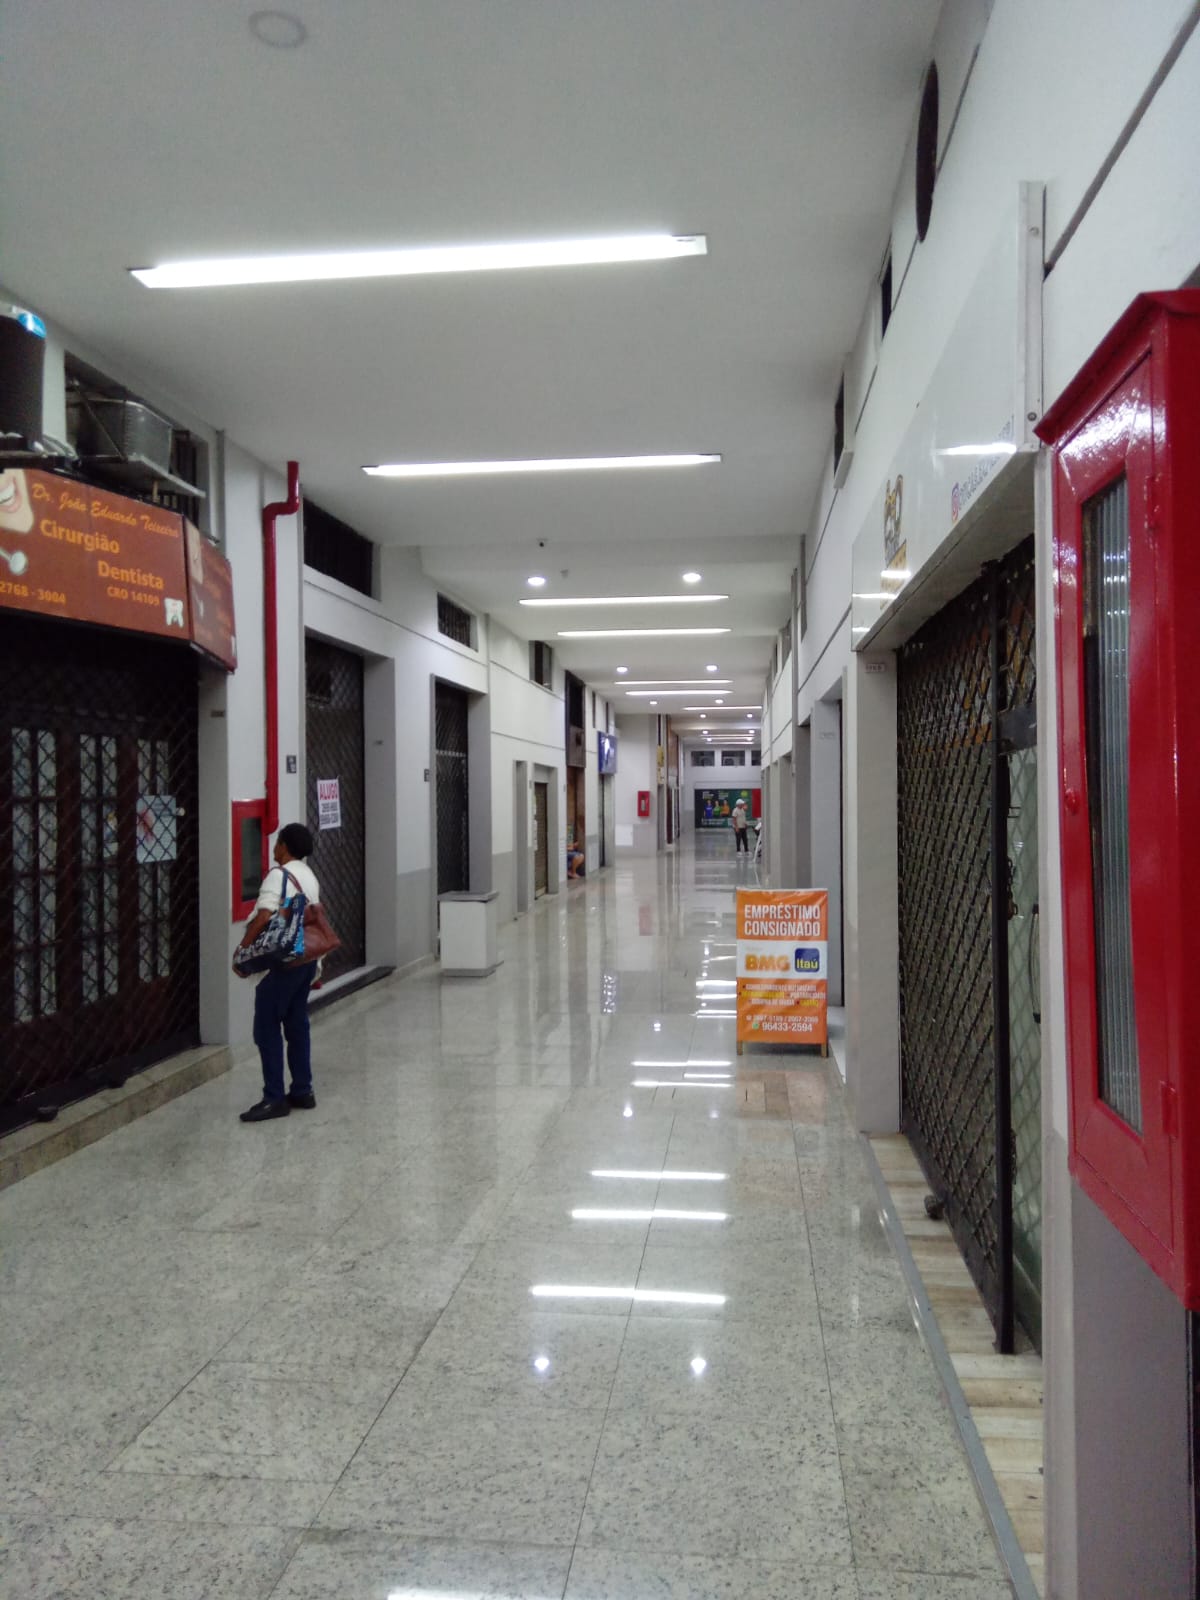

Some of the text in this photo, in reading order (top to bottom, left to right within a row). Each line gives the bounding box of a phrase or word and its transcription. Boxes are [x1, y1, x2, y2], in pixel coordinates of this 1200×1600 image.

[32, 484, 53, 502] Dr.
[60, 492, 87, 511] João
[90, 501, 137, 526] Eduardo
[40, 519, 120, 553] Cirurgião
[98, 560, 164, 590] Dentista
[0, 581, 28, 597] 2768
[107, 586, 129, 601] CRO
[744, 902, 820, 919] EMPRÉSTIMO
[744, 920, 820, 936] CONSIGNADO
[745, 954, 790, 971] BMG
[796, 958, 818, 969] Itaú
